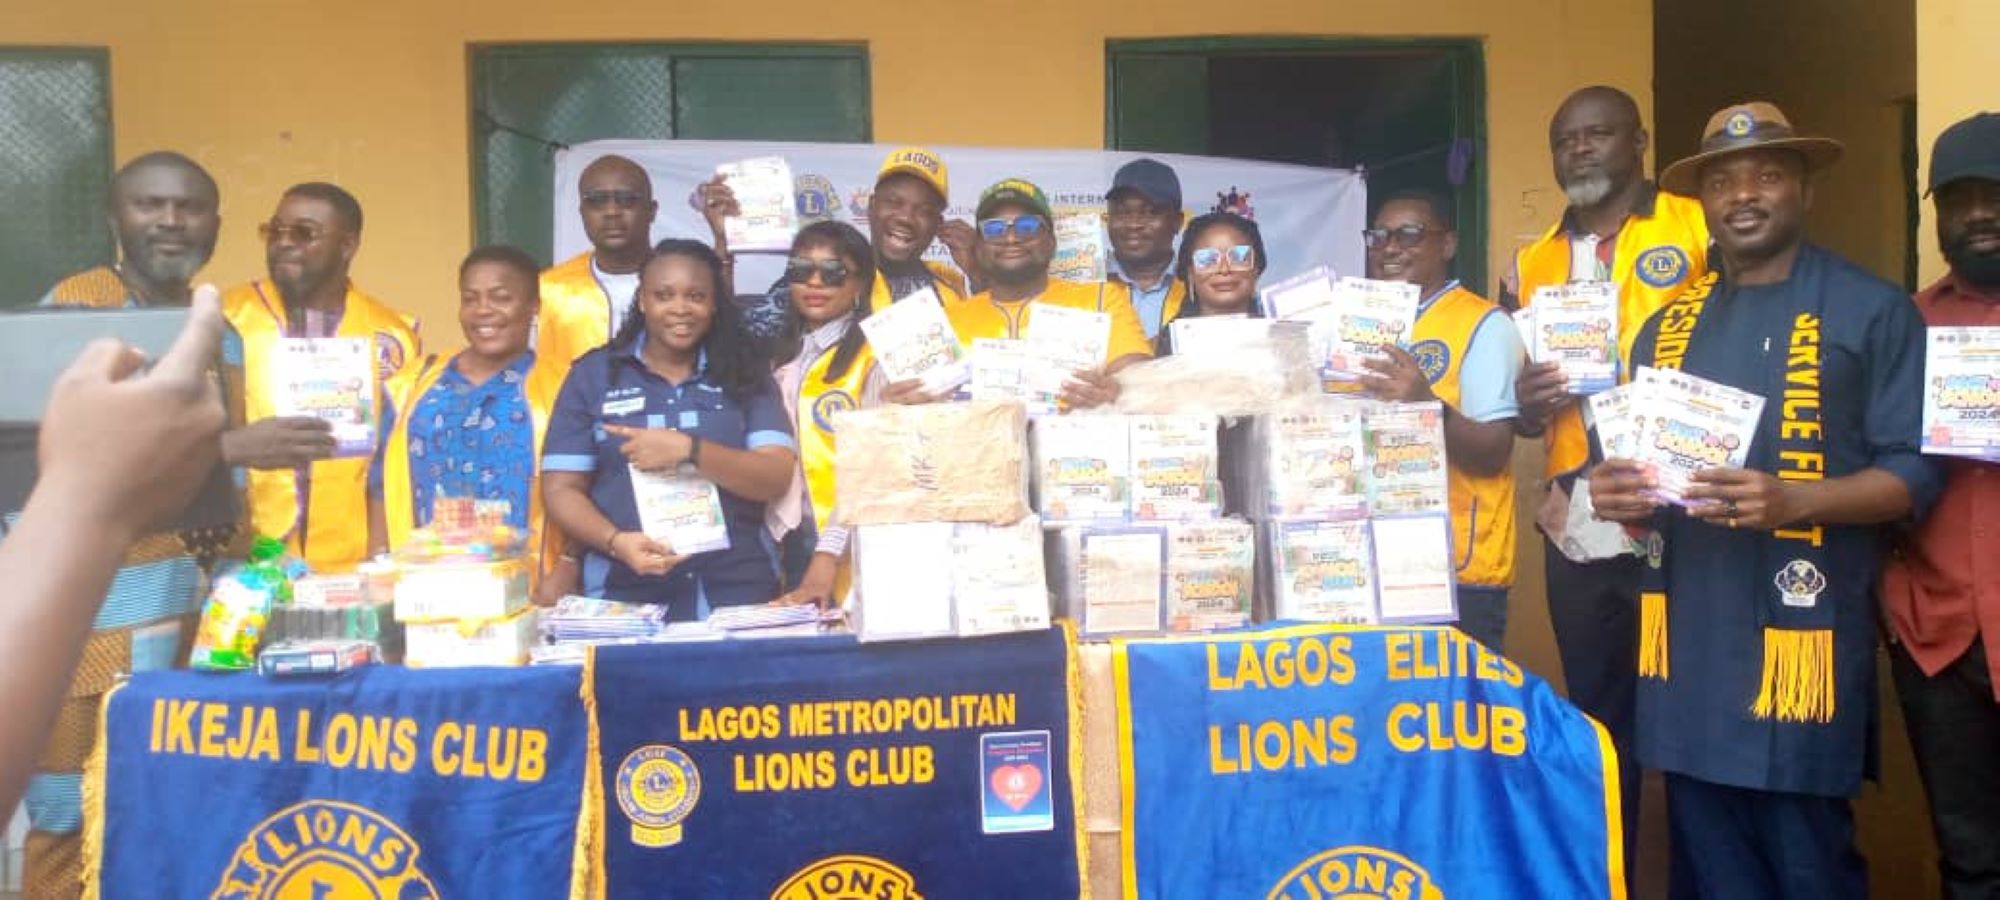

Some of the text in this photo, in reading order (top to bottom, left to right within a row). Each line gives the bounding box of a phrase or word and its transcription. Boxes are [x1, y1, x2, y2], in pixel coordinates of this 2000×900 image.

[895, 151, 938, 174] LAGOS
[1206, 634, 1355, 691] LAGOS
[150, 698, 549, 782] IKEJA LONS CLUB
[679, 693, 1016, 742] LAGOS METROPOLITAN
[1209, 701, 1527, 775] LIONS CLUB
[734, 750, 836, 792] LIONS
[847, 745, 934, 787] CLUB
[264, 808, 405, 871] LIONS
